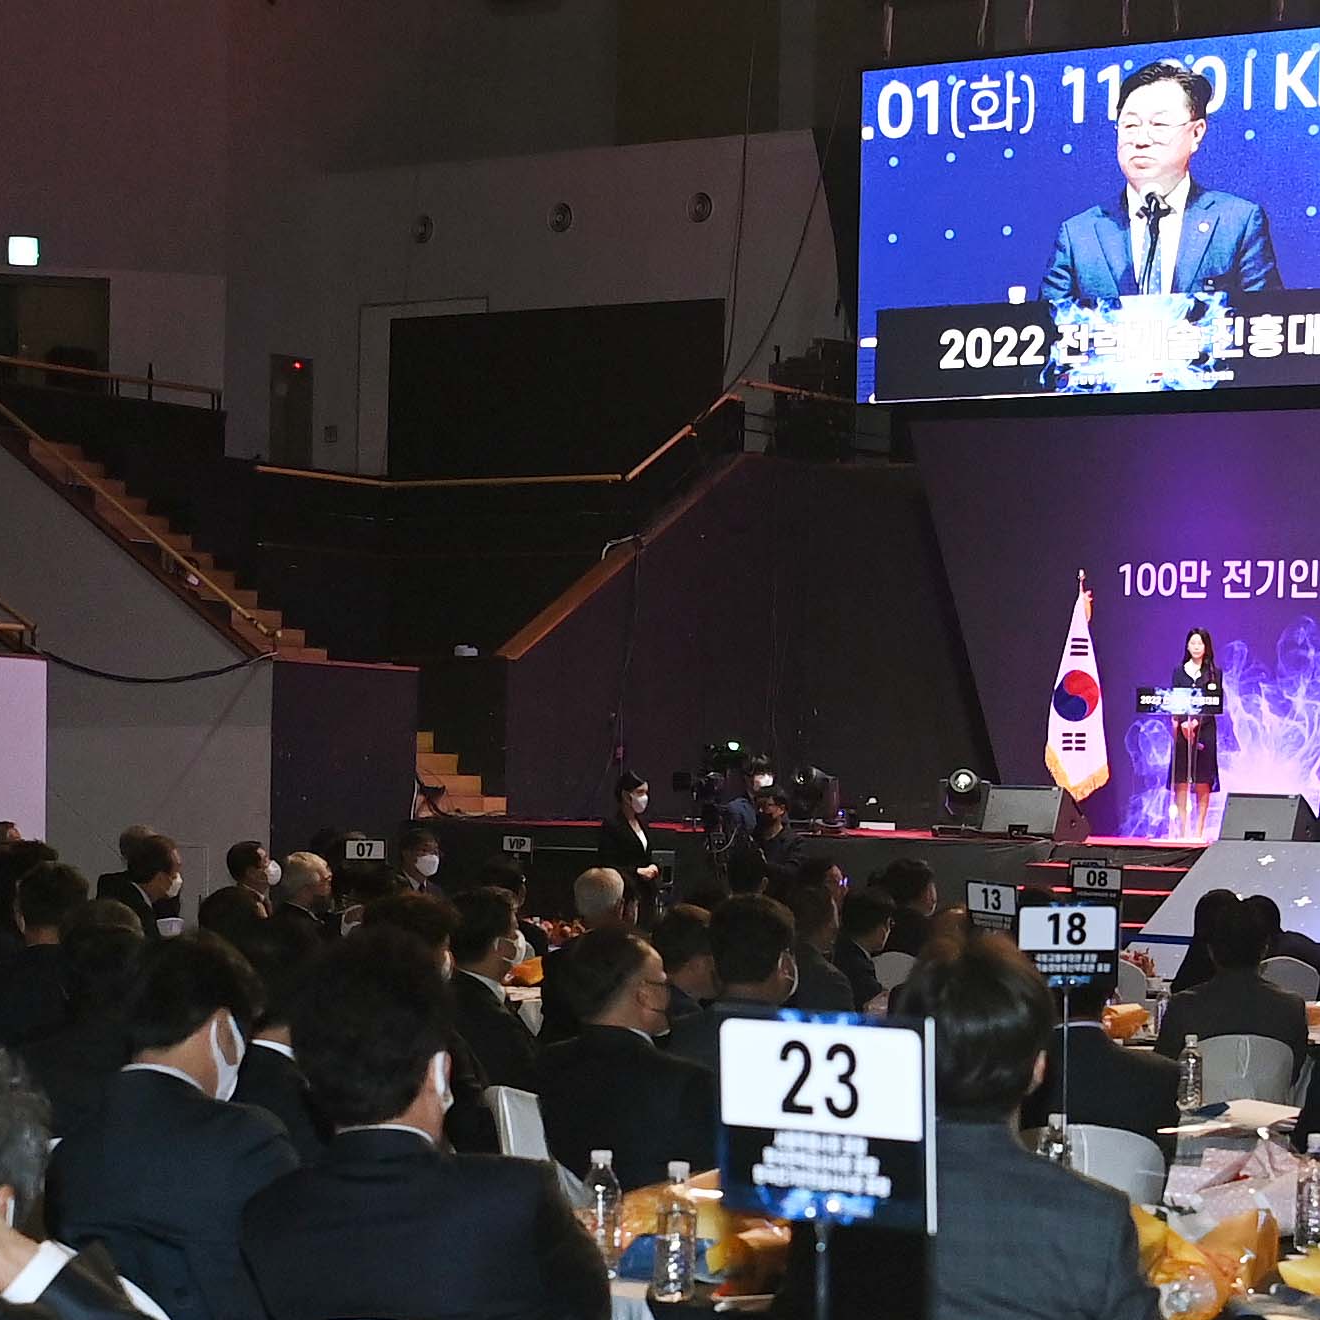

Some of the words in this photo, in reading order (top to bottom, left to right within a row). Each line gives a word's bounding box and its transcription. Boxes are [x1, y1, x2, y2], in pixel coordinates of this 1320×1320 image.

[939, 325, 1045, 370] 2022
[1118, 559, 1211, 599] 100만
[356, 843, 374, 857] 07
[508, 838, 526, 850] VIP
[1086, 870, 1108, 887] 08
[982, 888, 1002, 911] 13
[1047, 912, 1087, 946] 18
[780, 1040, 859, 1119] 23
